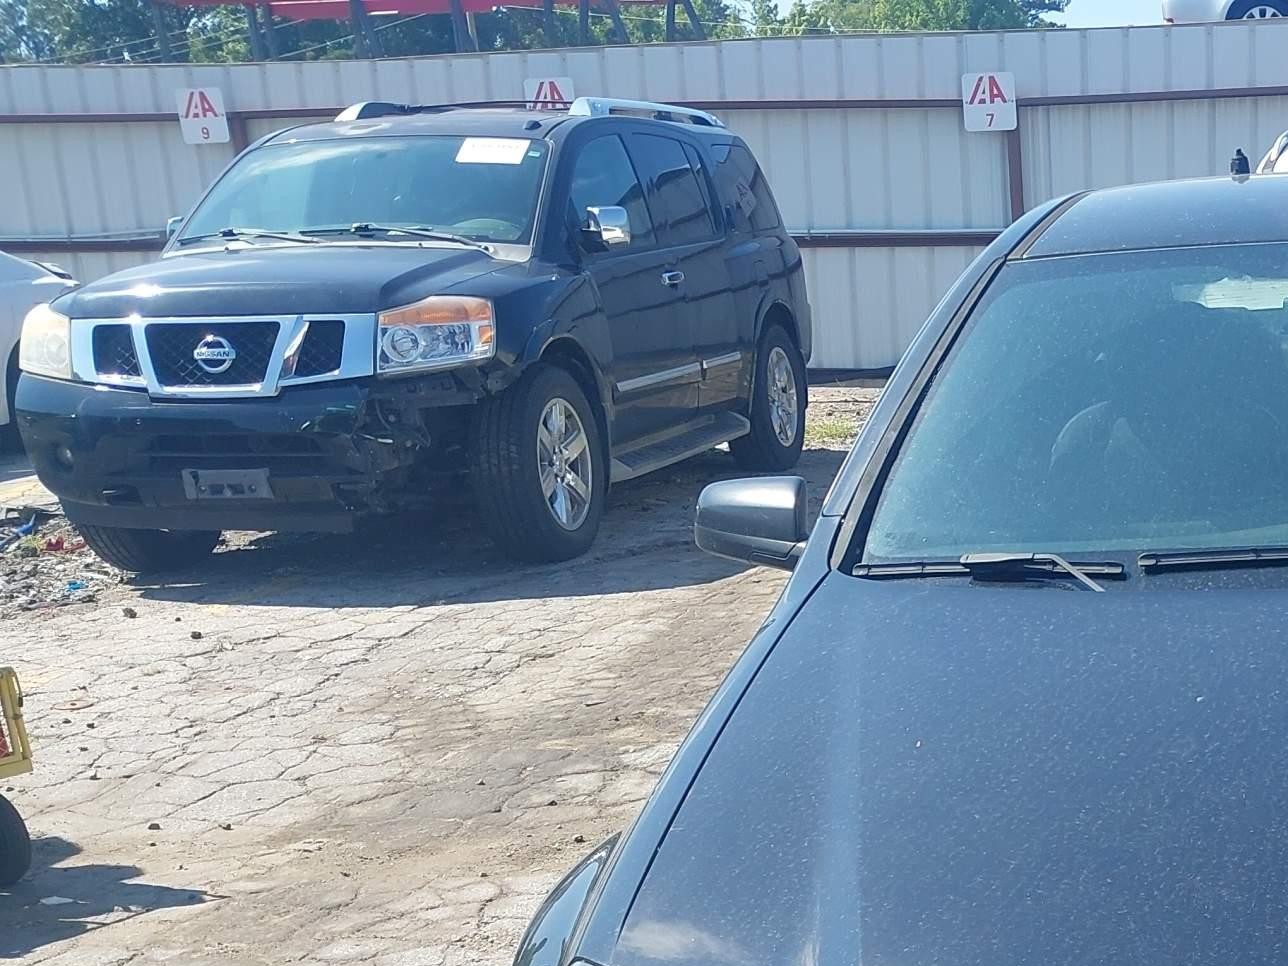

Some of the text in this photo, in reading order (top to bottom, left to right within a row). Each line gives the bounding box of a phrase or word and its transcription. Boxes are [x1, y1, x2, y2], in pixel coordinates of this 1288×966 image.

[985, 113, 995, 128] 7
[200, 126, 211, 140] 9
[196, 350, 230, 359] NISSAN
